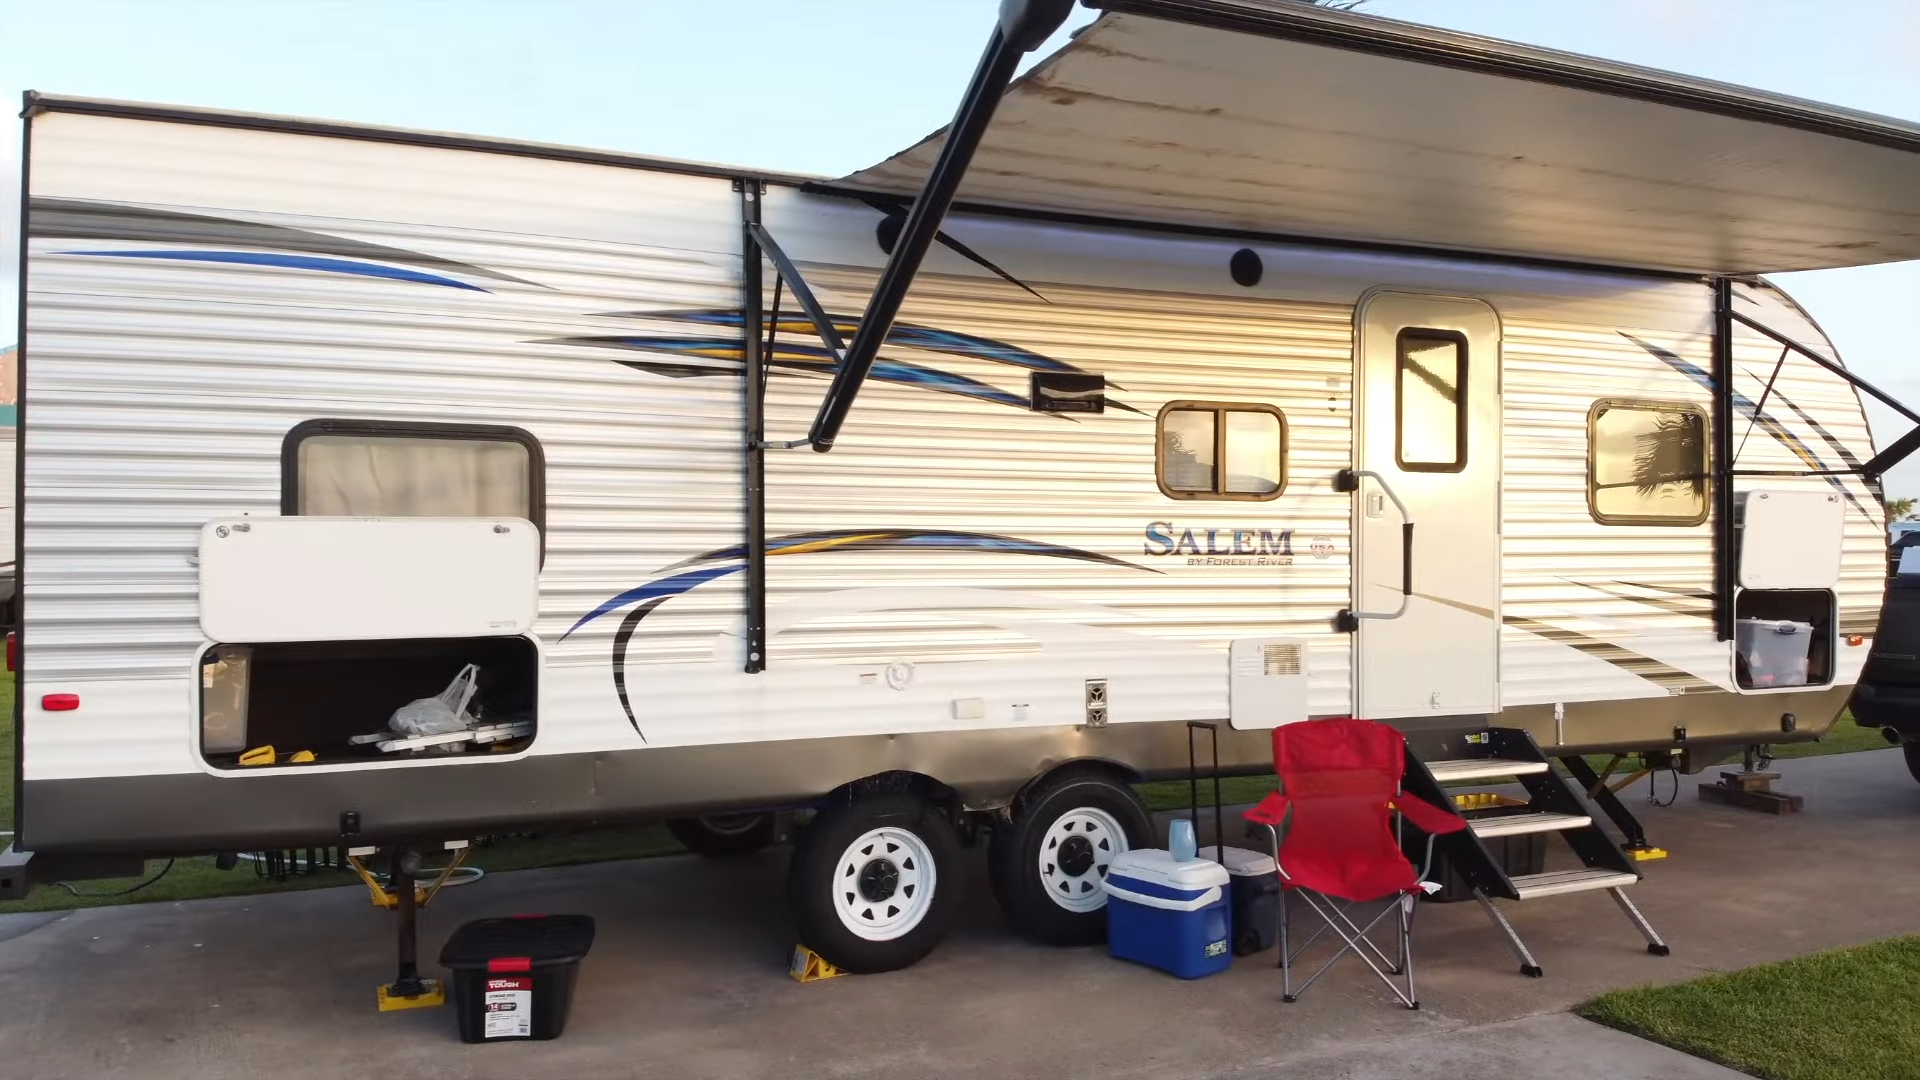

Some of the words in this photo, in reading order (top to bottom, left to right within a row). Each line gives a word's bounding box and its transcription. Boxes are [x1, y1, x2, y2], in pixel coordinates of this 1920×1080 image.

[1144, 521, 1295, 556] SALEM
[1310, 543, 1335, 551] USA
[1187, 558, 1203, 566] BY
[1206, 558, 1255, 566] FOREST
[1257, 558, 1293, 566] RIVER
